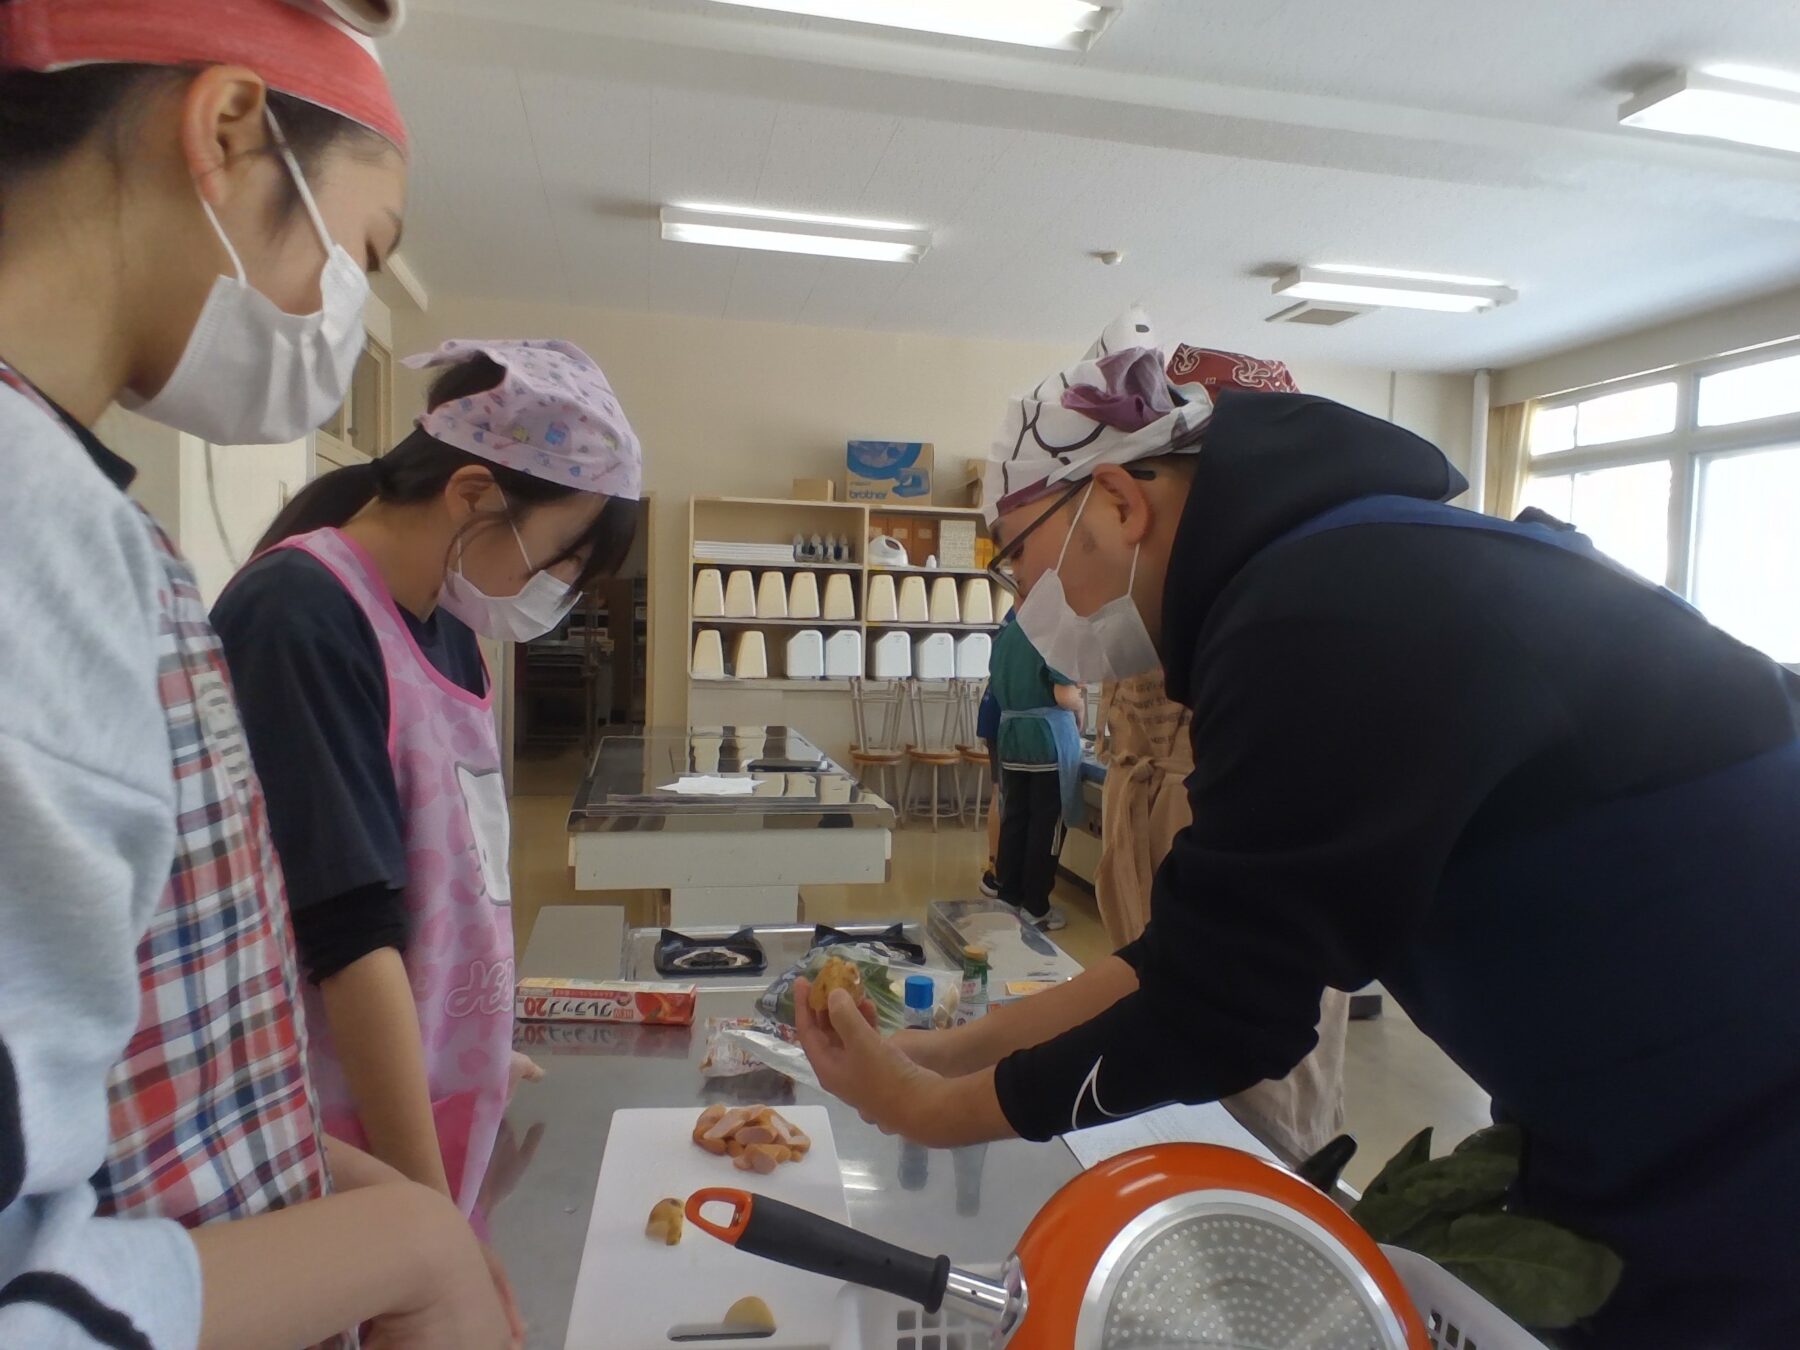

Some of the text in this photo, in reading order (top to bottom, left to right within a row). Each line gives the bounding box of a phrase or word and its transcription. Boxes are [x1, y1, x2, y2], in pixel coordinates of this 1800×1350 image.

[849, 488, 887, 499] brother
[548, 1001, 612, 1018] クレラップ
